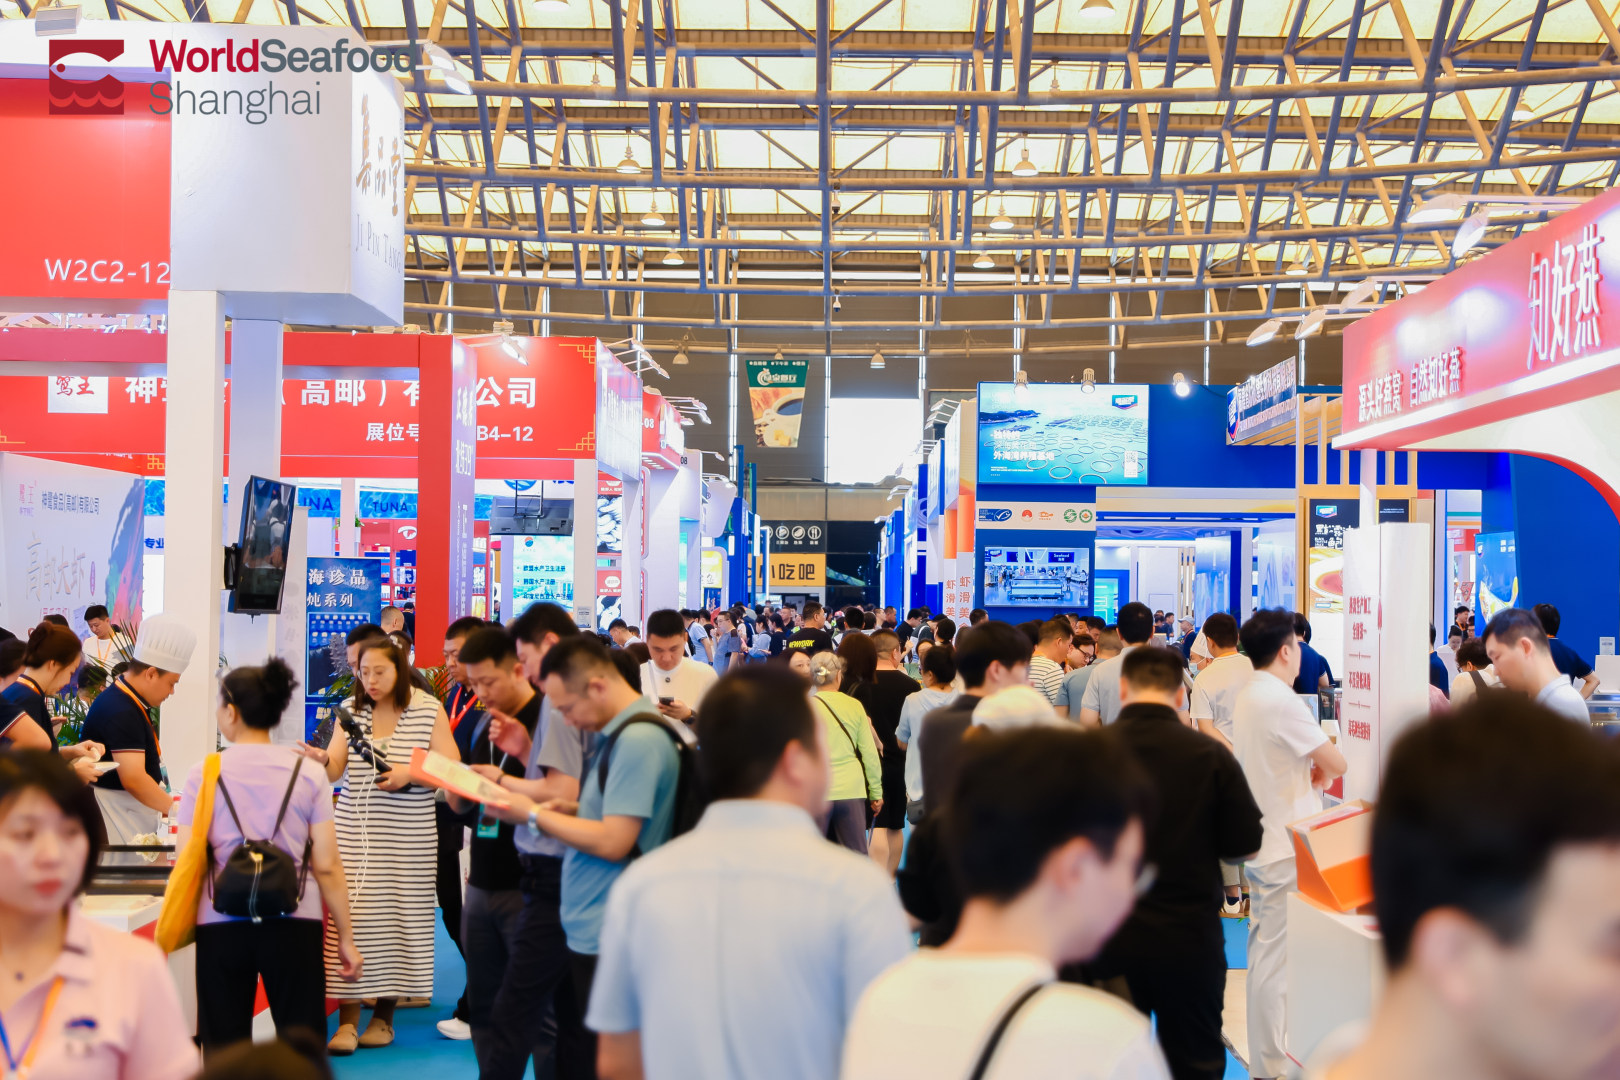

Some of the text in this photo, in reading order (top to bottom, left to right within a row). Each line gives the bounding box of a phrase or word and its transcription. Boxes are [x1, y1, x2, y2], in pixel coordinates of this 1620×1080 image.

[45, 258, 170, 284] W2C2-12
[1527, 224, 1603, 370] 知好燕
[1358, 369, 1402, 423] 源头好燕窝
[1410, 347, 1461, 407] 自然知好燕
[373, 502, 409, 513] TUNA
[308, 568, 367, 586] 海珍品
